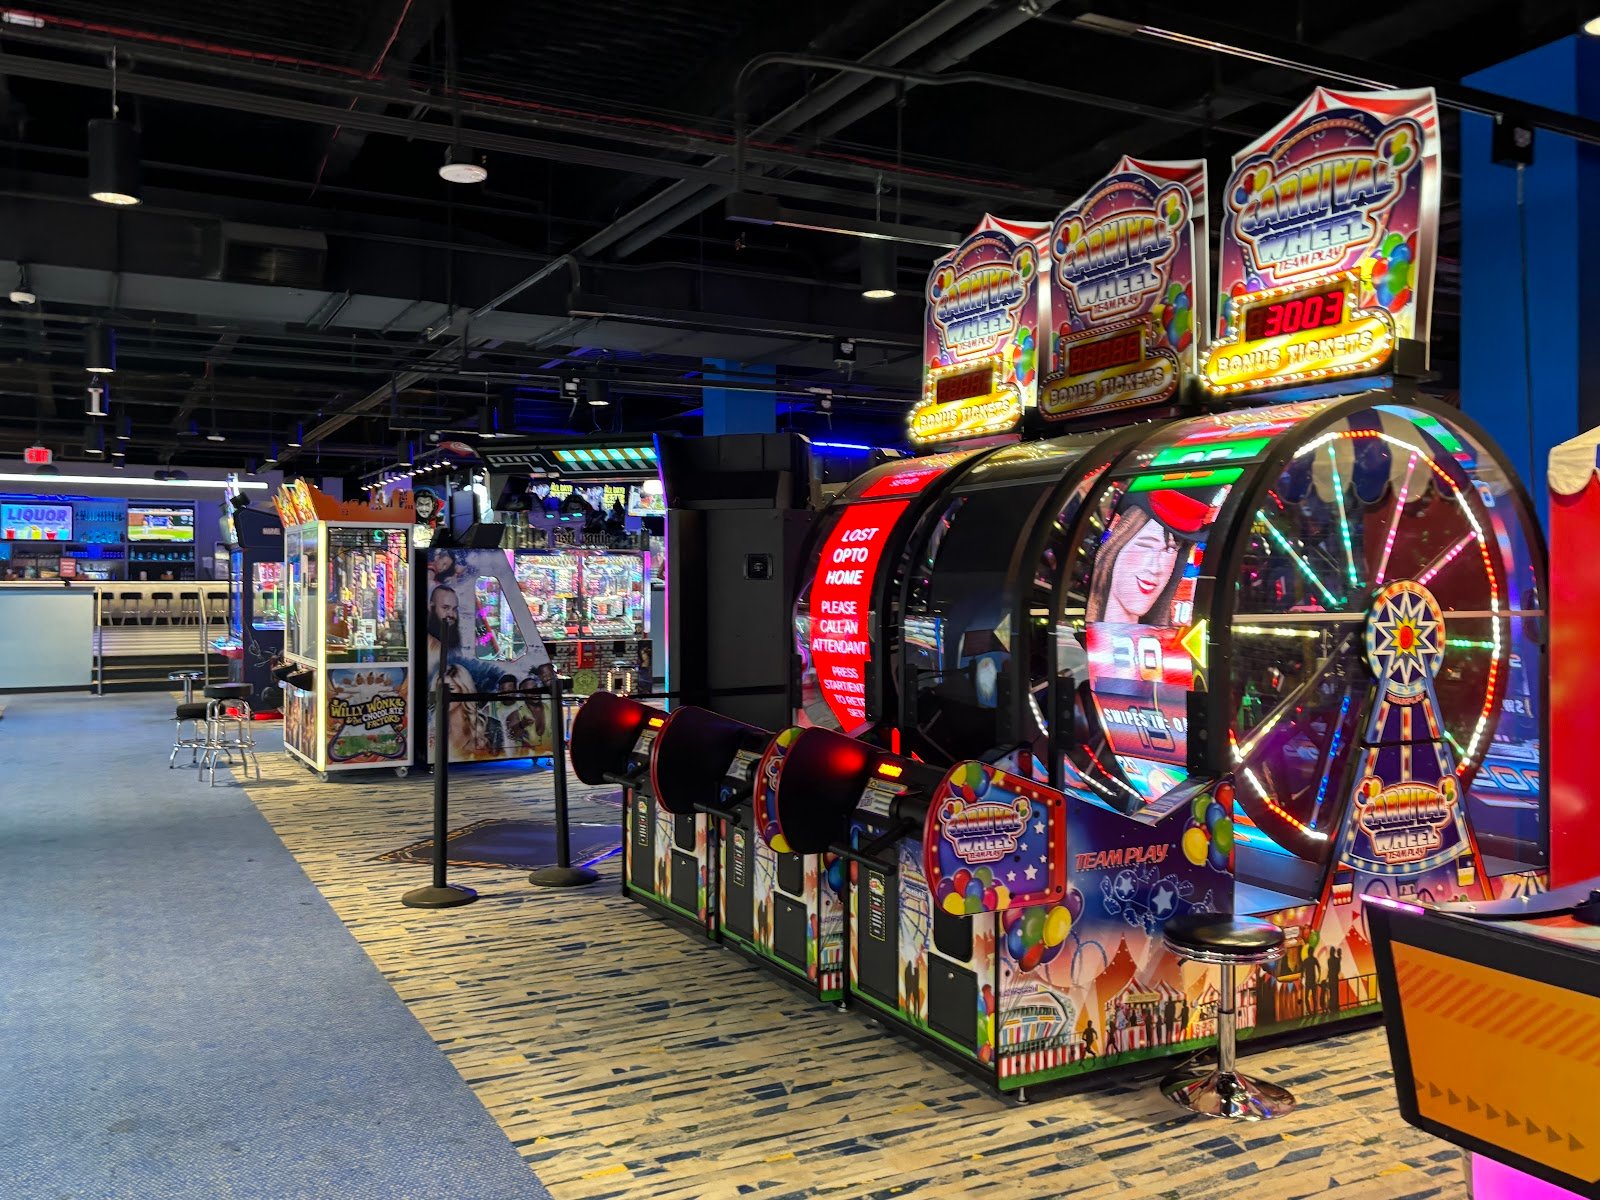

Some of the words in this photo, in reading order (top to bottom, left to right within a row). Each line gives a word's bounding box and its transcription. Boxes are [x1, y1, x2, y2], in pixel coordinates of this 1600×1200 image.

[1242, 158, 1394, 232] CARNIVAL
[1064, 217, 1172, 279] CARNIVAL
[1257, 212, 1371, 262] WHEEL
[937, 269, 1024, 320] CARNIVAL
[1077, 264, 1159, 306] WHEEL
[947, 309, 1011, 344] WHEEL
[1264, 290, 1344, 337] 3003
[1217, 347, 1281, 376] BONUS
[1286, 331, 1374, 365] TICKETS
[1051, 381, 1101, 406] BONUS
[1103, 368, 1164, 393] TICKETS
[920, 409, 958, 429] BONUS
[961, 400, 1010, 423] TICKETS
[8, 508, 67, 521] LIQUOR
[841, 528, 880, 541] LOST
[833, 548, 868, 563] OPTO
[826, 570, 864, 585] HOME
[821, 600, 857, 614] PLEASE
[820, 620, 843, 633] CALL
[844, 620, 858, 634] AN
[813, 638, 867, 655] ATTENDANT
[1112, 634, 1163, 681] 30
[832, 666, 859, 678] PRESS
[332, 699, 364, 717] WILLY
[362, 708, 403, 722] CHOCOLATE
[1103, 708, 1148, 727] SWIPES
[947, 807, 1021, 835] CARNIVAL
[1364, 787, 1449, 828] CARNIVAL
[958, 835, 1011, 852] WHEEL
[1374, 829, 1438, 852] WHEEL
[1074, 848, 1123, 872] TEAM
[1124, 844, 1169, 864] PLAY
